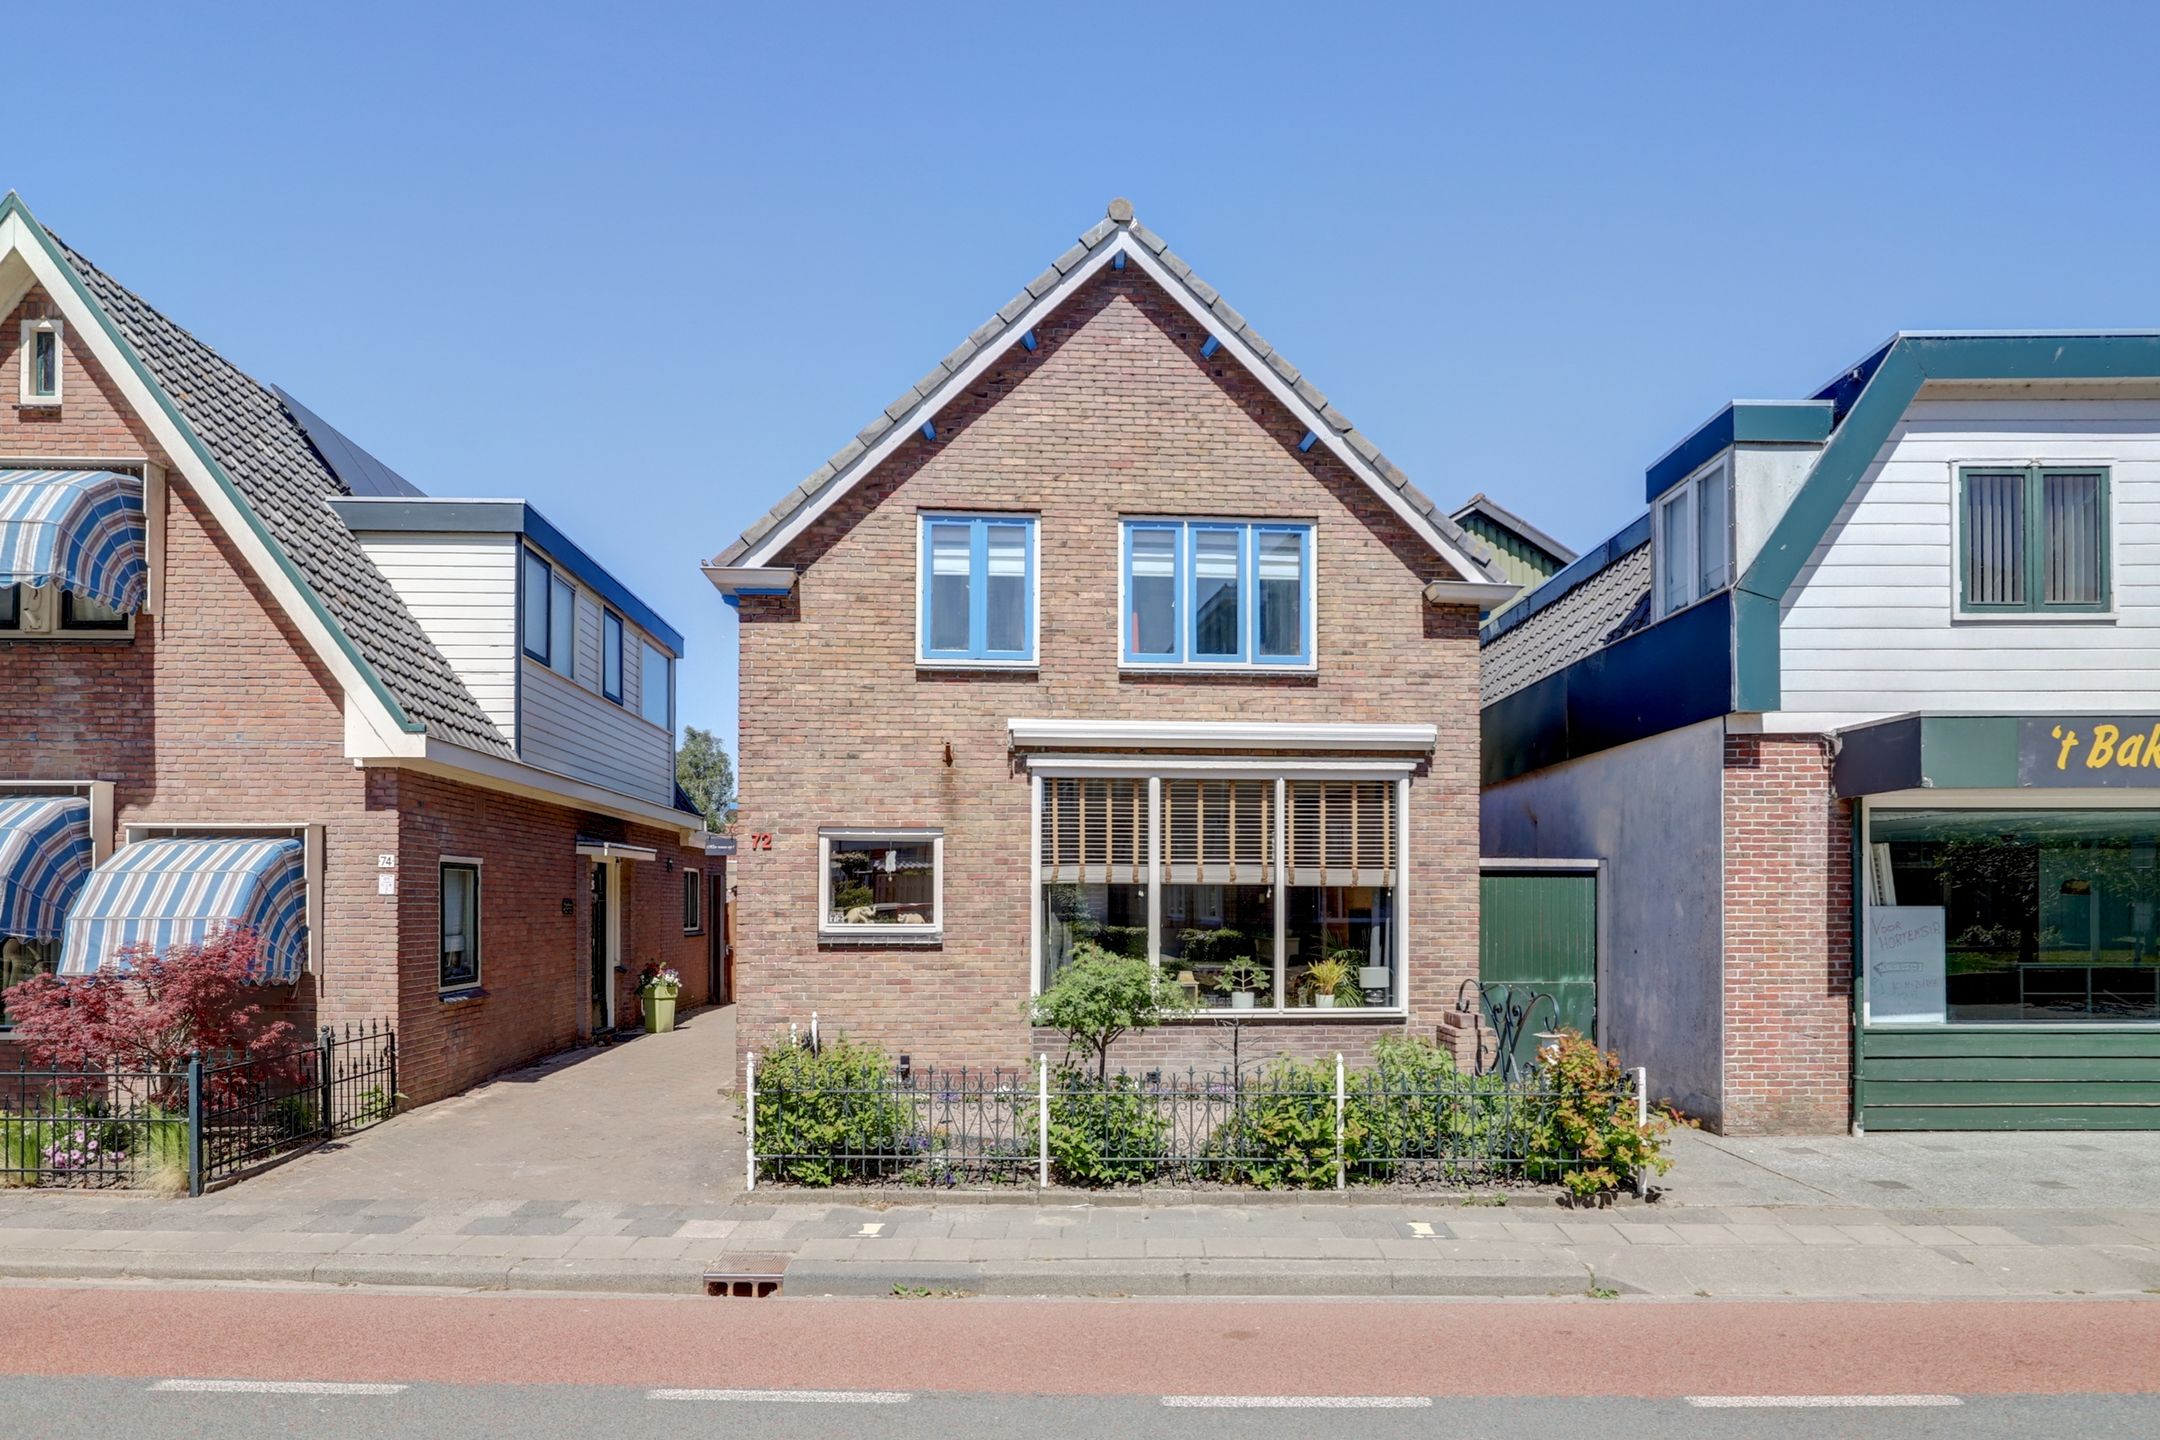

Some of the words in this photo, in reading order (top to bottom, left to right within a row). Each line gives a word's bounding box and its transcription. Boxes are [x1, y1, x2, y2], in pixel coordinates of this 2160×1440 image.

[2052, 725, 2079, 770] 't
[2086, 723, 2160, 769] Bak
[751, 832, 773, 851] 72
[380, 856, 392, 866] 74
